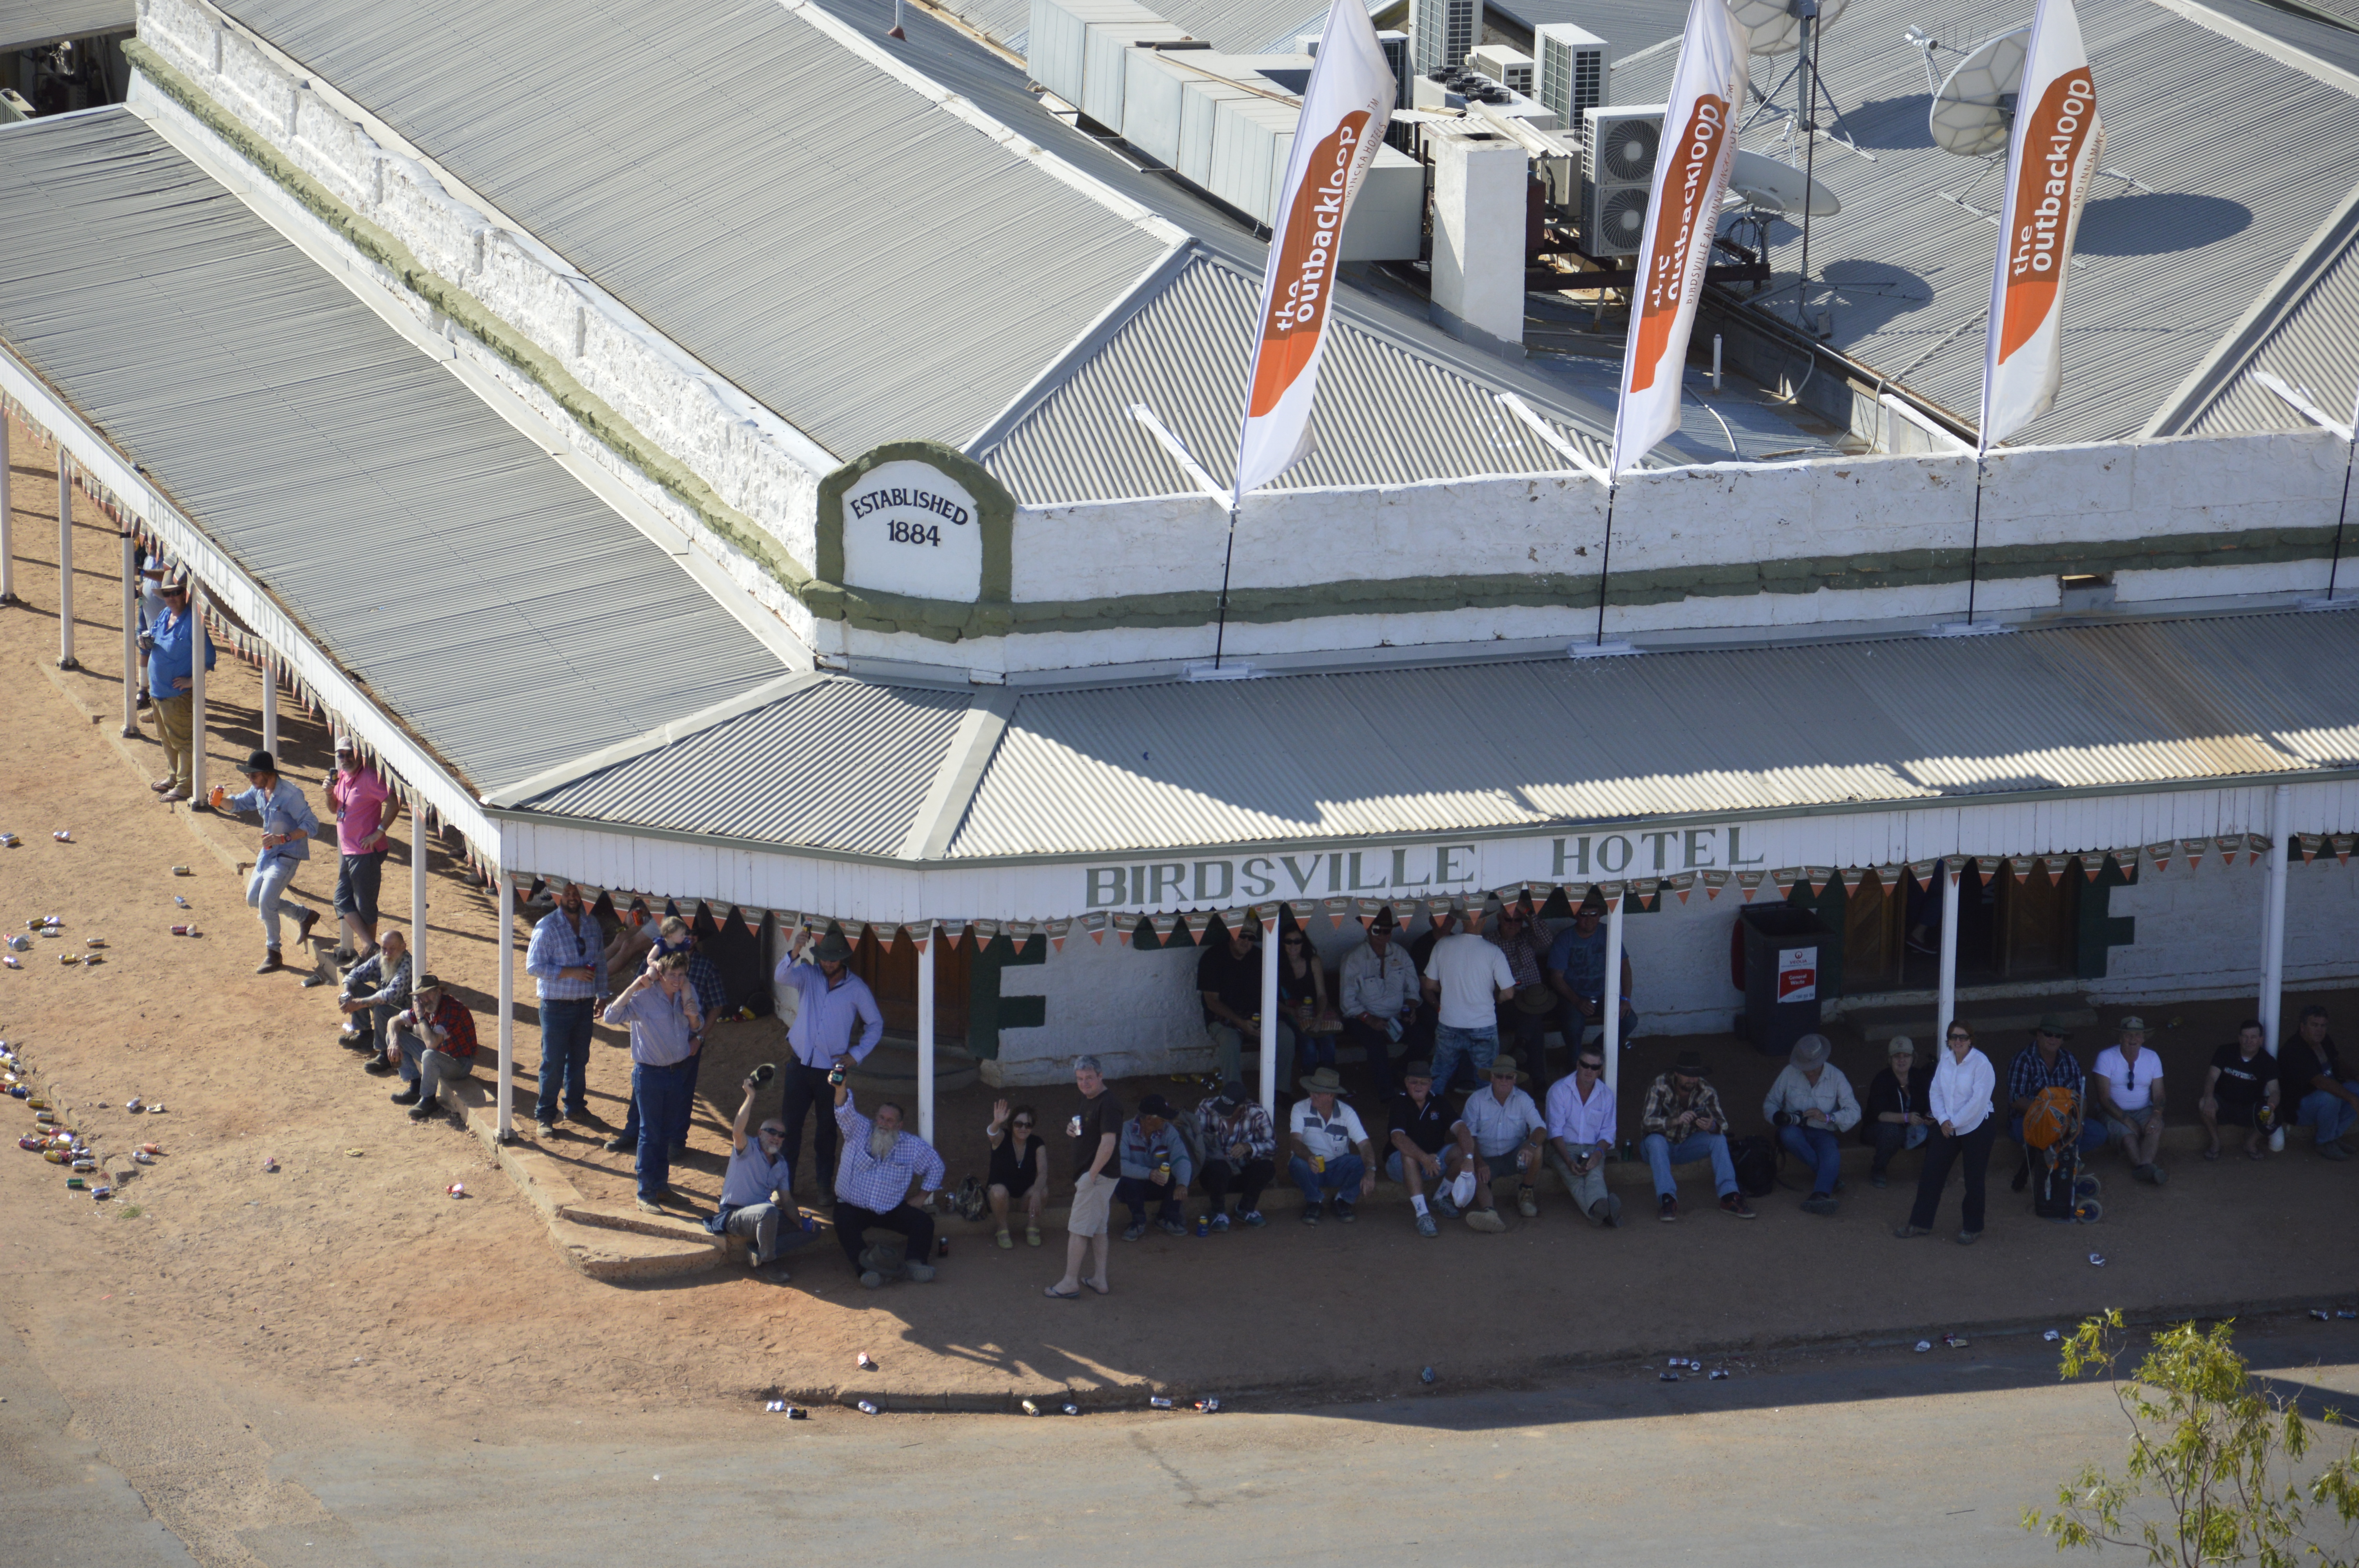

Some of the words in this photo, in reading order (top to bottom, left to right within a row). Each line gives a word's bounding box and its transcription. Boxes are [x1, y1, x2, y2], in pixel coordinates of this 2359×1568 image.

[1363, 122, 1387, 154] HOTELS
[2032, 78, 2094, 272] outbackloop
[2073, 186, 2084, 209] AND
[1297, 126, 1356, 322] outbackloop
[1686, 242, 1708, 304] BIRDSVILLE
[1703, 217, 1716, 240] AND
[2013, 225, 2032, 276] the
[1275, 279, 1299, 331] the
[849, 488, 968, 526] ESTABLISHED
[887, 519, 941, 547] 1884
[1086, 844, 1475, 908] BIRDSVILLE
[1552, 827, 1764, 877] HOTEL
